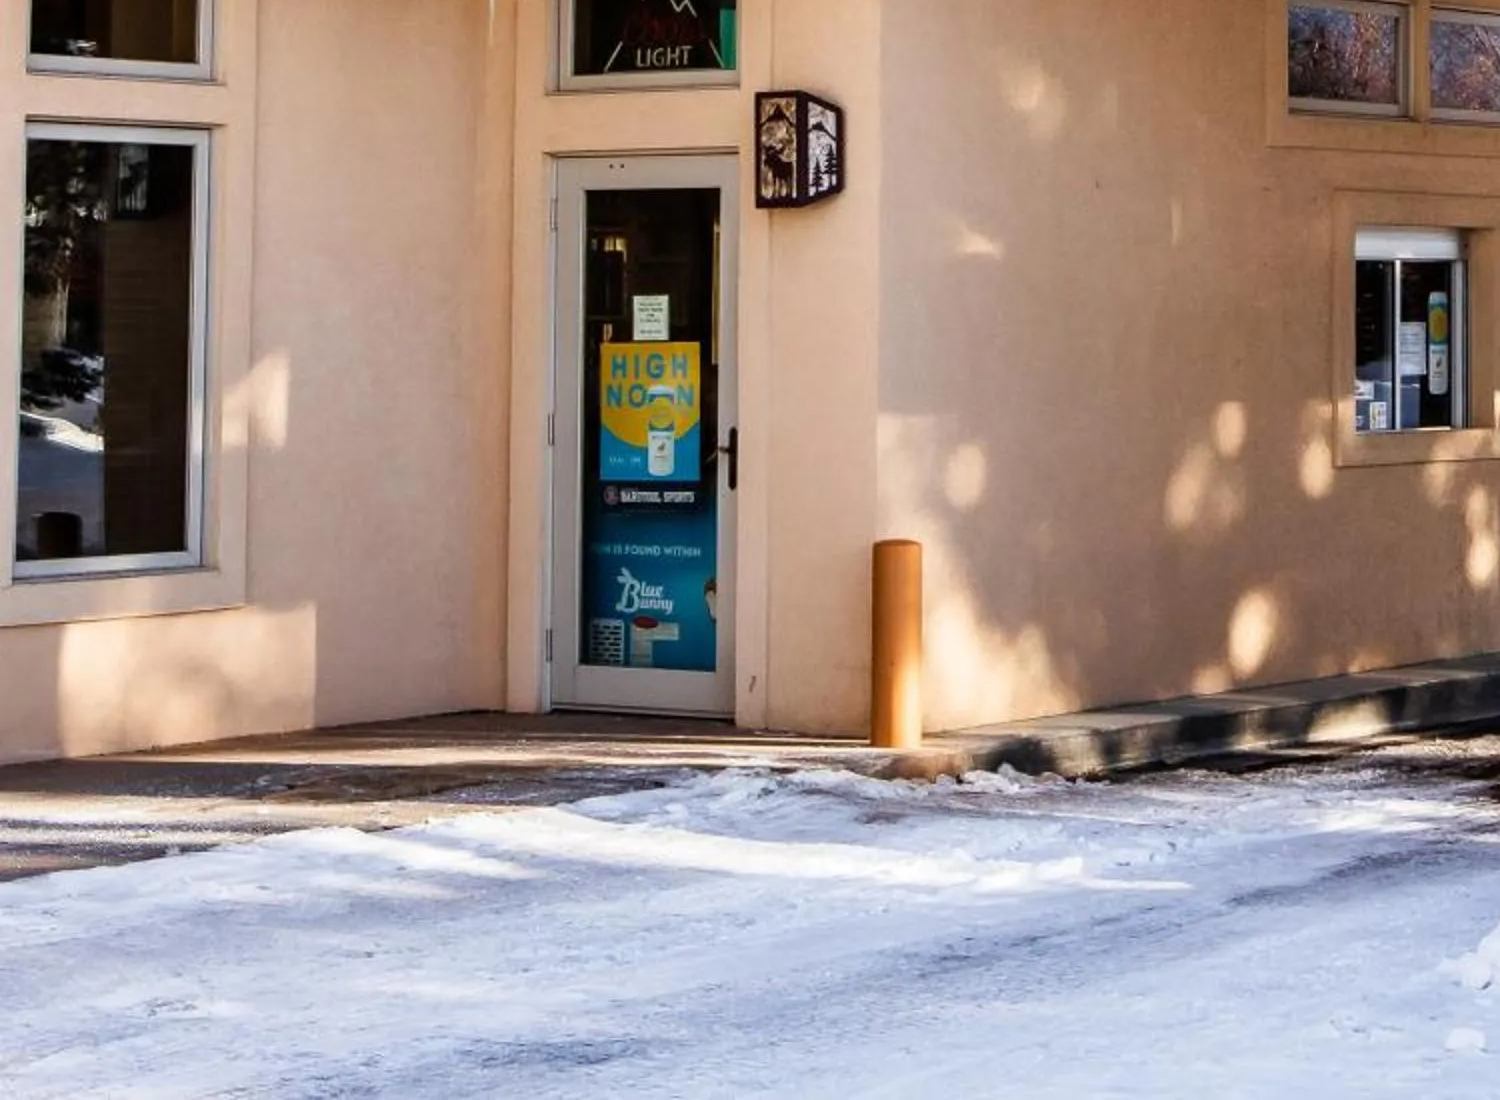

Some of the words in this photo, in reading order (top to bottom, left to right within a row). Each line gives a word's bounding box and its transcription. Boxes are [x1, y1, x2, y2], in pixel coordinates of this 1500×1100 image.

[635, 45, 693, 68] LIGHT
[611, 352, 689, 380] HIGH
[606, 383, 695, 409] NON
[623, 543, 662, 558] FOUND
[615, 567, 664, 606] Blue
